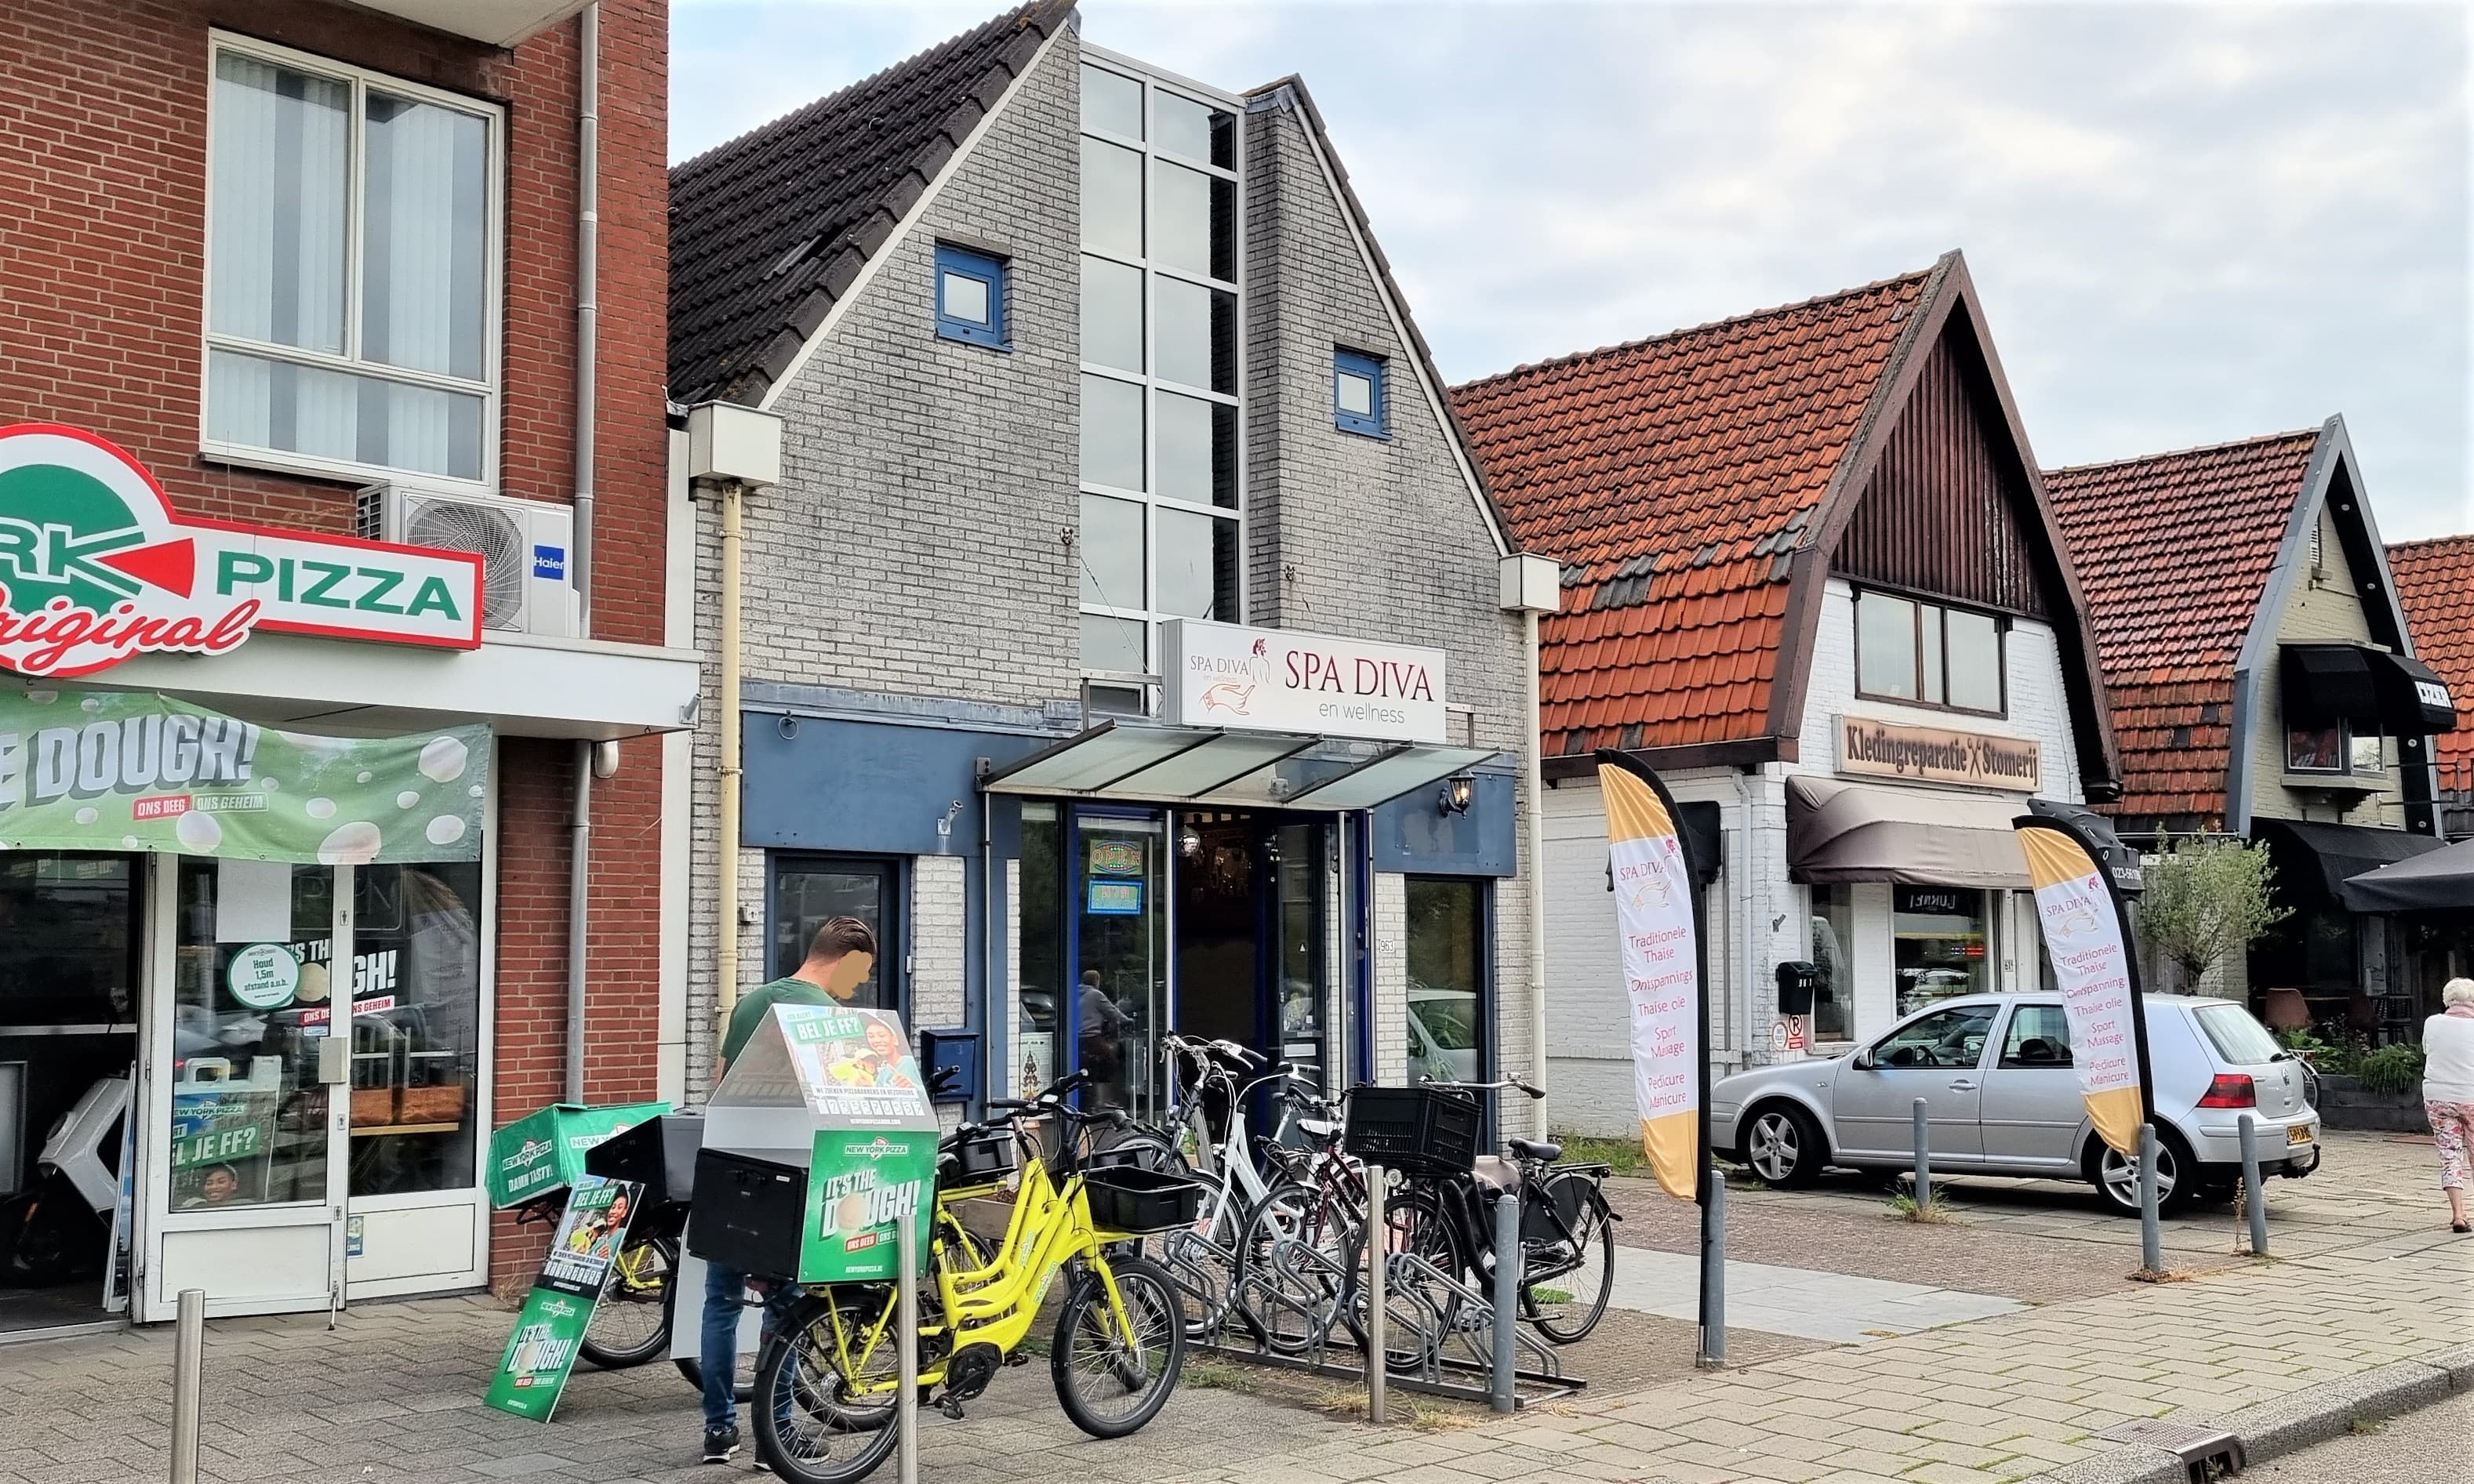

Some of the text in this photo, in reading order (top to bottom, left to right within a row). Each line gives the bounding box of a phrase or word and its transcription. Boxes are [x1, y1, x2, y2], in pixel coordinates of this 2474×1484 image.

[533, 556, 564, 570] Haier
[216, 550, 462, 621] PIZZA
[0, 593, 261, 671] riginal
[1190, 655, 1248, 675] SPA DIVA
[1286, 650, 1434, 702] SPA DIVA
[1320, 702, 1404, 724] en wellness
[35, 713, 260, 800] DOUGH!
[1847, 725, 2038, 786] Kledingreparatie Stomerij
[137, 793, 264, 816] ONS DEEG ONS GEHEIM
[1092, 849, 1141, 865] OPEN
[1620, 866, 1638, 881] SPA
[2046, 897, 2091, 917] SPA DIVA
[1380, 940, 1393, 952] 963
[1629, 926, 1686, 949] Traditionele
[310, 938, 331, 960] TH
[1644, 948, 1674, 963] Thaise
[2060, 943, 2117, 967] Traditionele
[252, 958, 274, 969] Houd
[2076, 961, 2107, 976] Thaise
[256, 970, 274, 980] 1,5m
[1799, 978, 1812, 988] 961
[244, 981, 269, 991] afstand
[303, 998, 391, 1023] ONS DE NS GEHEIM
[1638, 1001, 1668, 1017] Thaise
[2105, 998, 2122, 1009] olie
[796, 1017, 859, 1041] BEL JE FF?
[2091, 1020, 2115, 1033] Sport
[2087, 1033, 2124, 1048] Massage
[2089, 1057, 2126, 1072] Pedicure
[1648, 1073, 1685, 1090] Pedicure
[2091, 1071, 2129, 1086] Manicure
[1649, 1092, 1686, 1109] Manicure
[191, 1106, 214, 1116] YORK
[192, 1135, 214, 1162] JE
[220, 1127, 256, 1156] FF?
[572, 1137, 600, 1148] NEW
[508, 1163, 554, 1192] DAMN TASTY!
[826, 1168, 877, 1199] IT'S THE
[573, 1191, 591, 1208] BEL
[847, 1239, 859, 1250] ONS
[859, 1235, 875, 1248] DEEG
